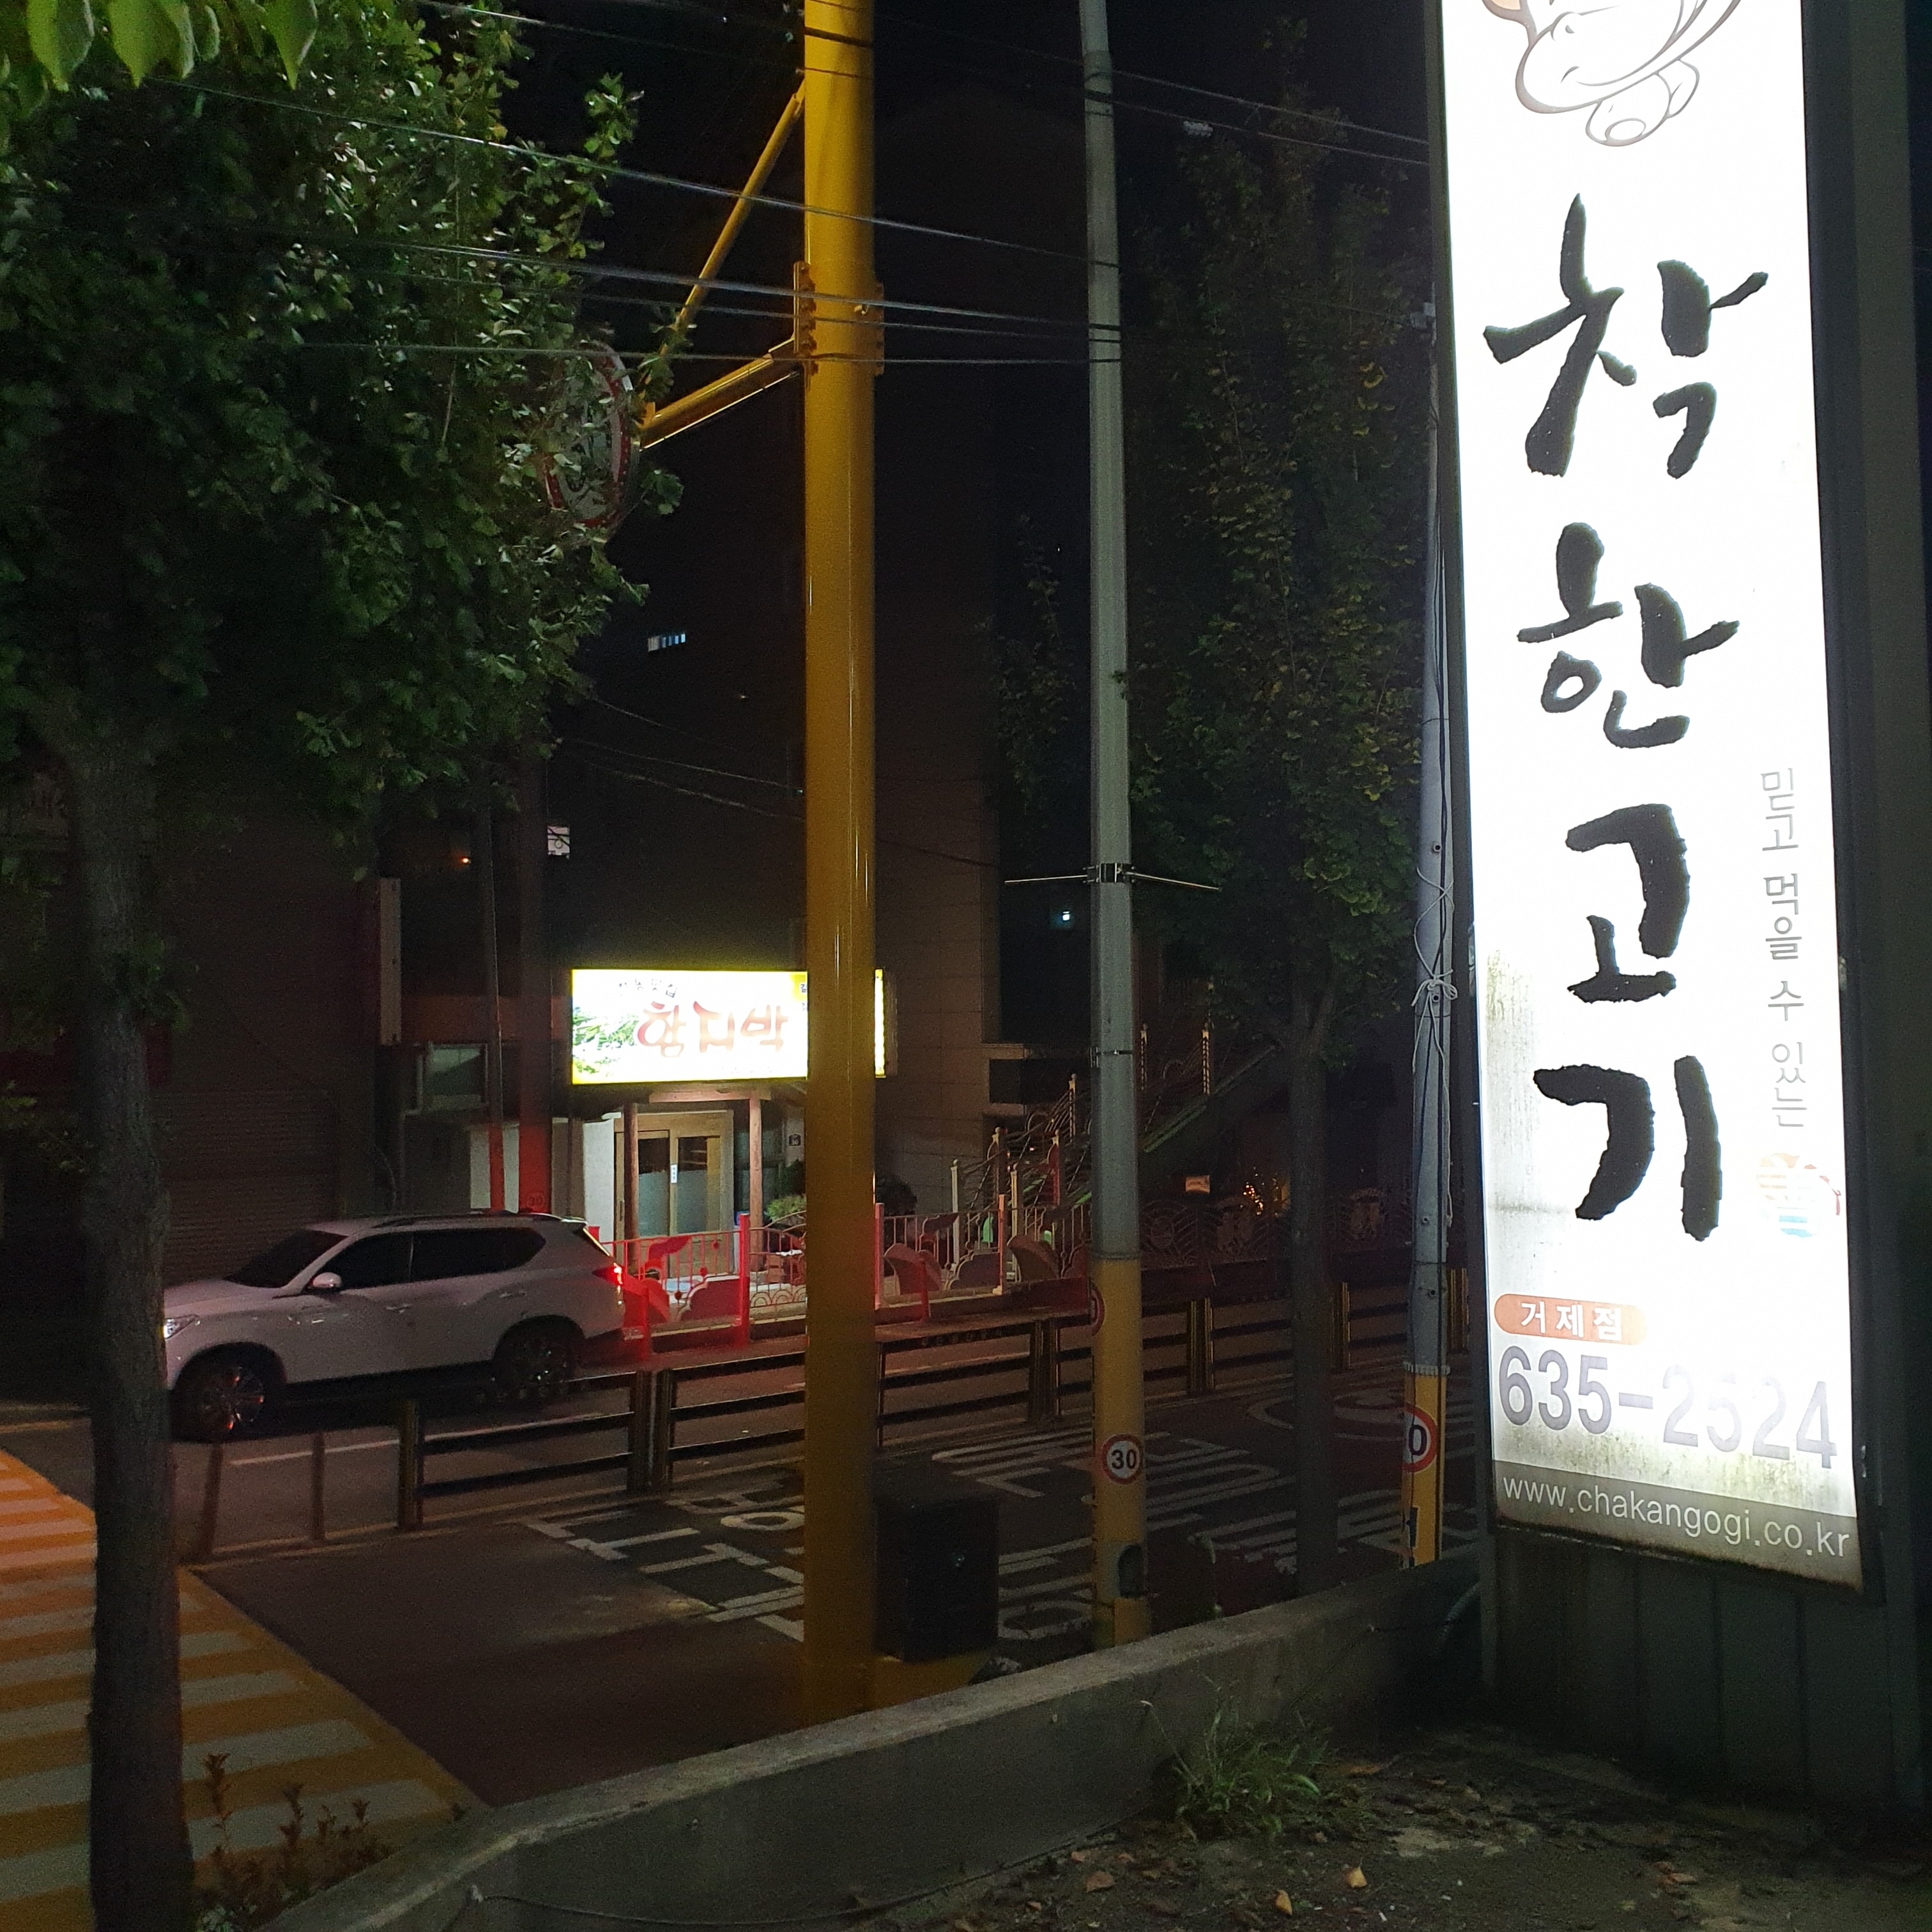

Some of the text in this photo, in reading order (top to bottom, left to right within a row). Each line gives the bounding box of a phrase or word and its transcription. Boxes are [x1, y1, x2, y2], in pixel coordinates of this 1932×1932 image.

[1483, 194, 1768, 1242] 착한고기
[1759, 767, 1808, 1128] 믿고 먹을 수 있는
[1521, 1301, 1622, 1341] 거제점
[1499, 1345, 1837, 1469] 635-2524
[1112, 1449, 1137, 1469] 30
[1503, 1475, 1850, 1557] www.chakangogi.co.kr
